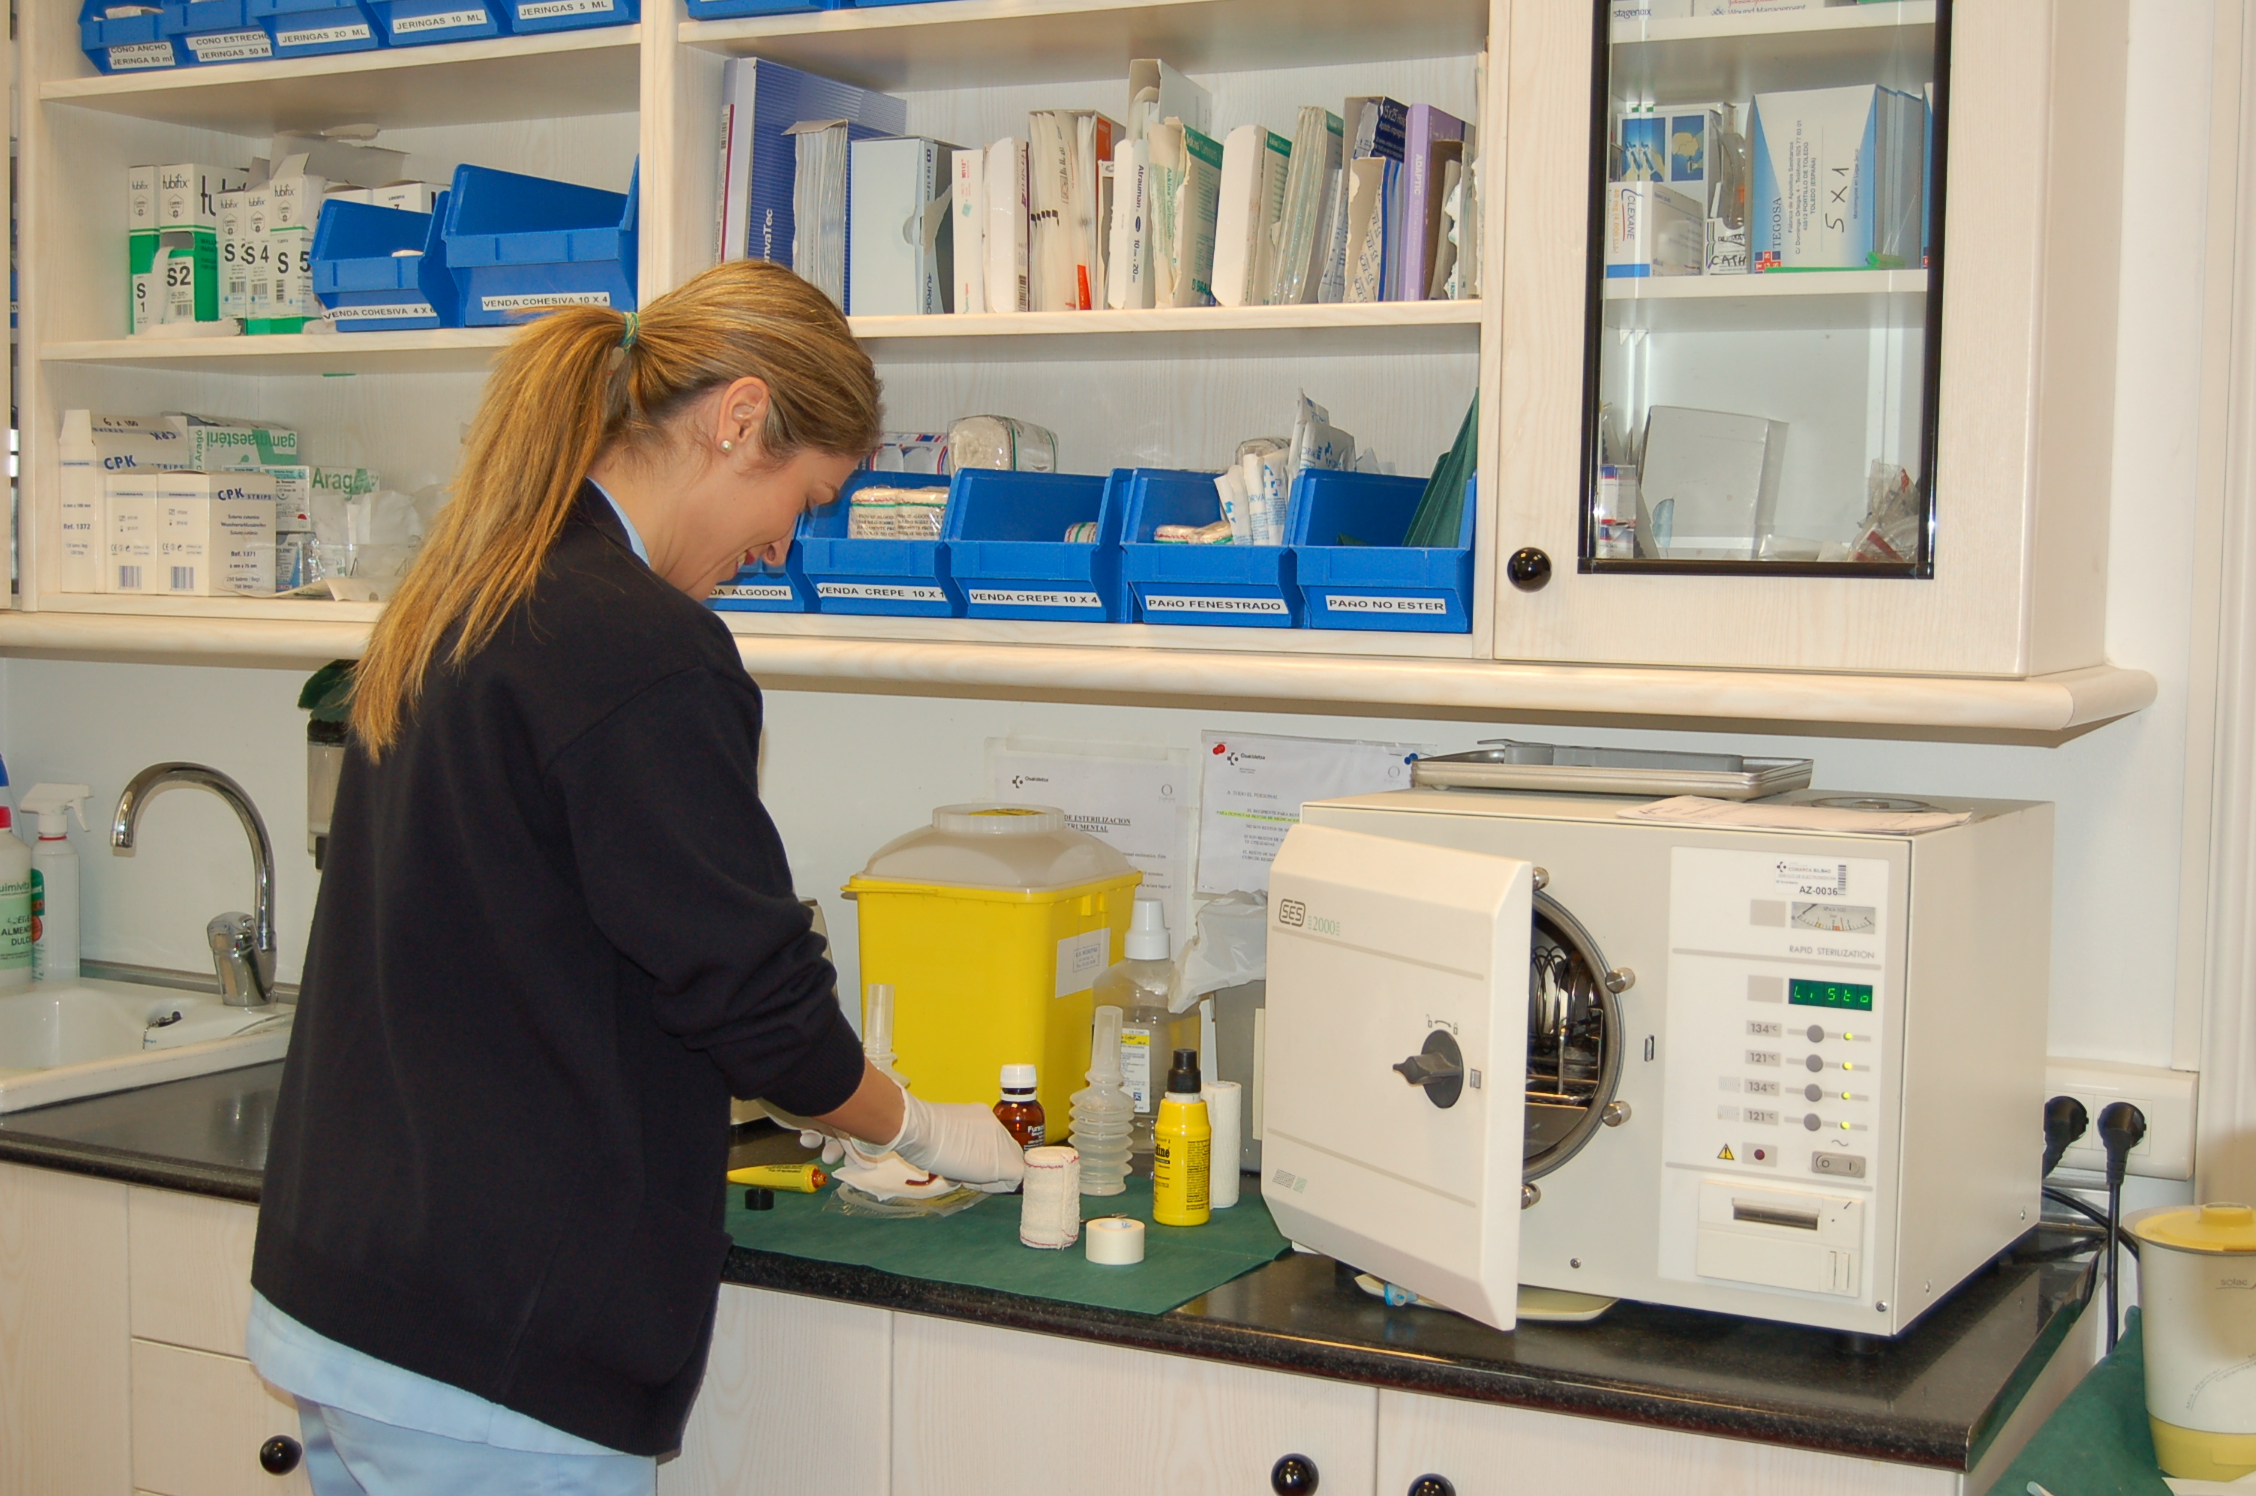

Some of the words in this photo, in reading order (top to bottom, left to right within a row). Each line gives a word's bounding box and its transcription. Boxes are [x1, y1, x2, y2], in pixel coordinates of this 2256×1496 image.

[520, 3, 574, 17] JERINGAS
[579, 2, 586, 10] 5
[591, 0, 608, 9] ML
[396, 17, 446, 30] JERINGAS
[452, 15, 461, 23] 10
[466, 14, 483, 23] ML
[196, 38, 221, 46] CONO
[282, 31, 330, 43] JERINGAS
[352, 28, 366, 36] ML
[110, 46, 134, 54] CONO
[137, 44, 167, 52] ANCHO
[200, 48, 244, 59] JERINGAS
[112, 56, 149, 66] JERINGA
[1414, 154, 1424, 195] ADAPTIC
[1832, 167, 1849, 177] 1
[1136, 164, 1144, 208] Atrauman
[1627, 195, 1636, 240] CLEXANE
[1772, 197, 1781, 248] TEGOSA
[1825, 213, 1844, 233] 5
[764, 208, 773, 264] onvaTec
[1134, 239, 1140, 248] 10
[224, 244, 235, 262] S
[260, 245, 269, 263] 4
[278, 252, 289, 274] S
[1133, 264, 1139, 275] 20
[166, 266, 191, 286] S2
[137, 283, 146, 299] S
[141, 302, 145, 313] 1
[483, 297, 518, 307] VENDA
[522, 296, 575, 306] COHESIVA
[579, 296, 589, 304] 10
[592, 296, 599, 304] X
[322, 308, 359, 320] VENDA
[361, 308, 403, 317] COHESIVA
[150, 431, 177, 440] CPK
[207, 430, 296, 448] gammaestéril
[195, 429, 203, 462] Aragó
[104, 455, 137, 470] CPK
[218, 488, 244, 501] CPK
[731, 588, 787, 597] ALGODON
[818, 587, 859, 597] VENDA
[865, 588, 905, 597] CREPE
[912, 590, 925, 598] 10
[970, 593, 1013, 602] VENDA
[1017, 594, 1059, 603] CREPE
[1063, 595, 1076, 603] 10
[1090, 596, 1098, 604] 4
[1189, 600, 1281, 610] FENESTRADO
[1373, 600, 1392, 609] NO
[1398, 601, 1444, 611] ESTER
[1074, 816, 1130, 825] ESTERILIZACION
[1799, 886, 1838, 895] AZ-0036
[1789, 945, 1813, 954] RAPID
[1817, 948, 1874, 958] STERILIZATION
[1156, 1144, 1170, 1158] dine
[2220, 1278, 2248, 1286] solac
